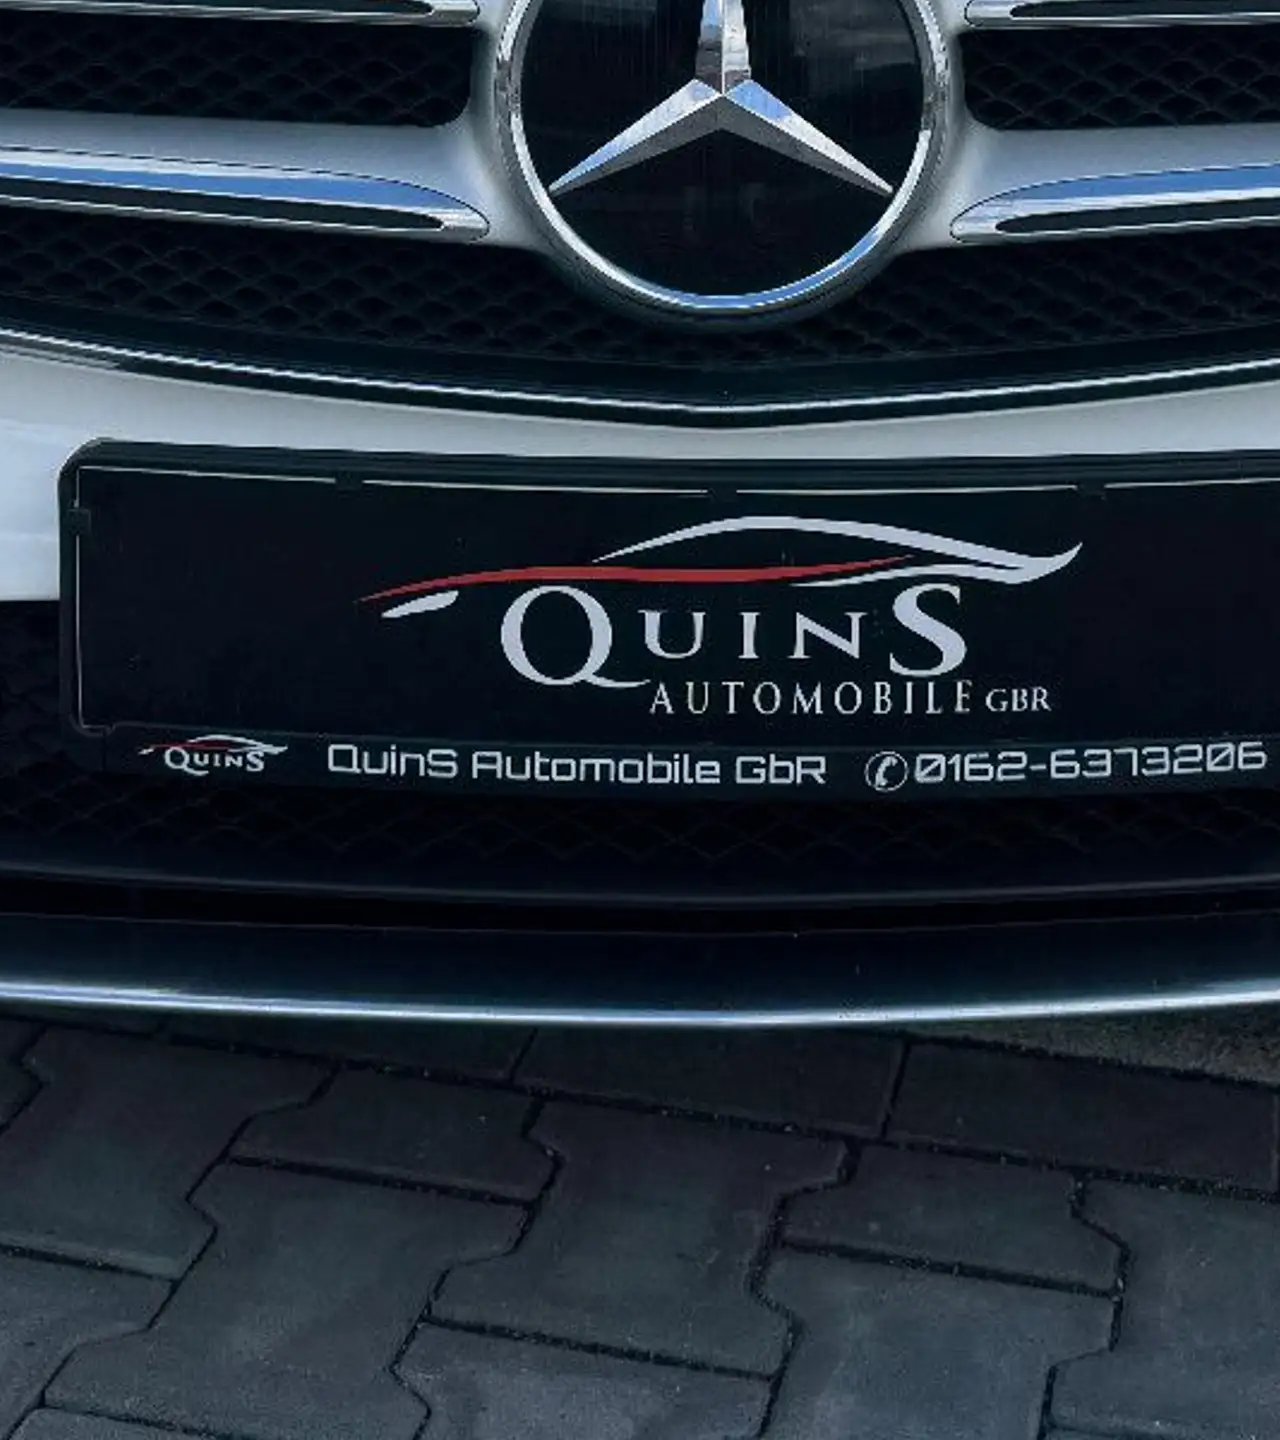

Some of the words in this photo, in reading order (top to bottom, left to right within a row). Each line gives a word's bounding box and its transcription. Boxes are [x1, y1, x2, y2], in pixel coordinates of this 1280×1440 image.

[649, 680, 973, 716] AUTOMOBILE
[326, 743, 459, 779] QuinS
[471, 750, 722, 785] Automobile
[734, 753, 827, 785] GbR
[914, 741, 1269, 784] 0162-6373206
